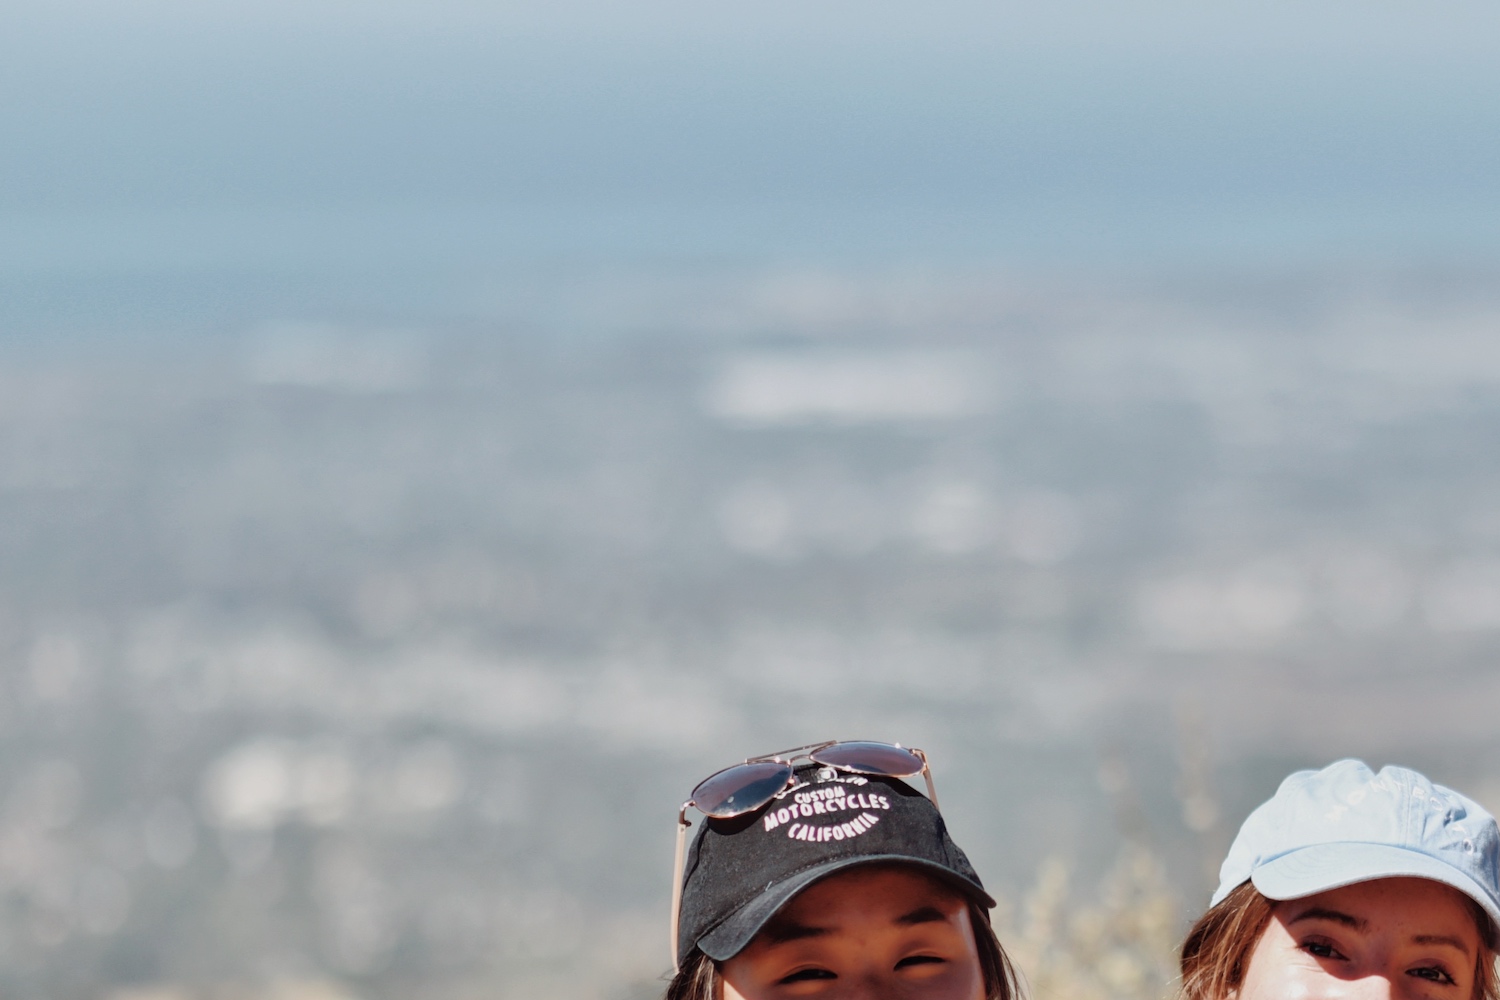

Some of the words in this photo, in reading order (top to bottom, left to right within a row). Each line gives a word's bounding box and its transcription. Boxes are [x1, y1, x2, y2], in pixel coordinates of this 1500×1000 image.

[794, 785, 846, 805] CUSTOM
[764, 793, 890, 832] MOTORCYCLES
[788, 812, 880, 842] CALIFORNIA
[1323, 779, 1475, 856] MONTECTO
